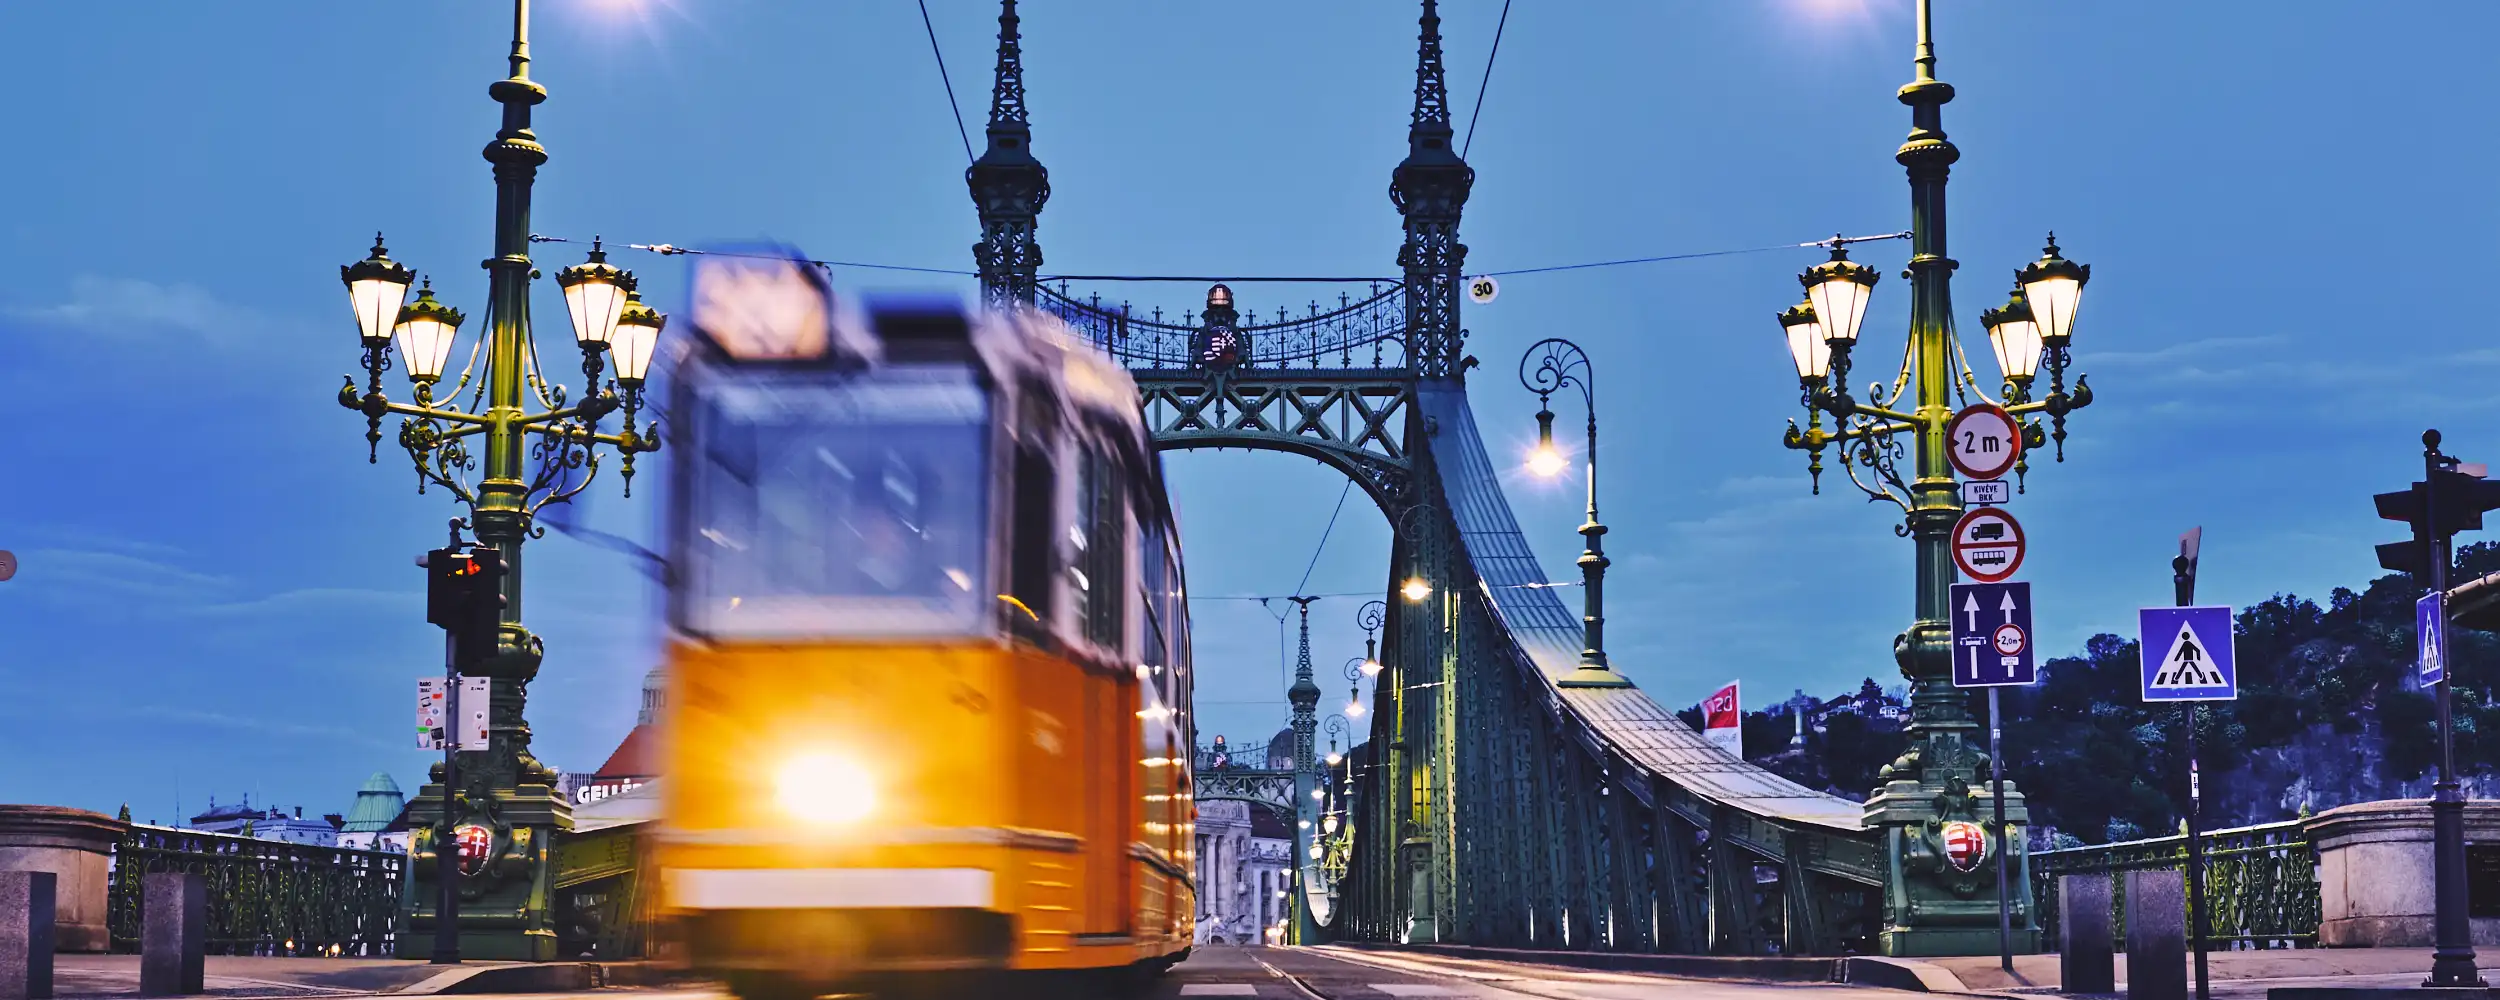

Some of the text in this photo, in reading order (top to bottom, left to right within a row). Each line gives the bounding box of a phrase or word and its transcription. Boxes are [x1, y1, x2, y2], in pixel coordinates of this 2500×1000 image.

[1474, 282, 1492, 296] 30
[1964, 431, 1999, 453] 2 m
[1974, 484, 1998, 493] KIVÉVE
[1979, 494, 1993, 502] BKK
[577, 778, 642, 804] GELLÉ
